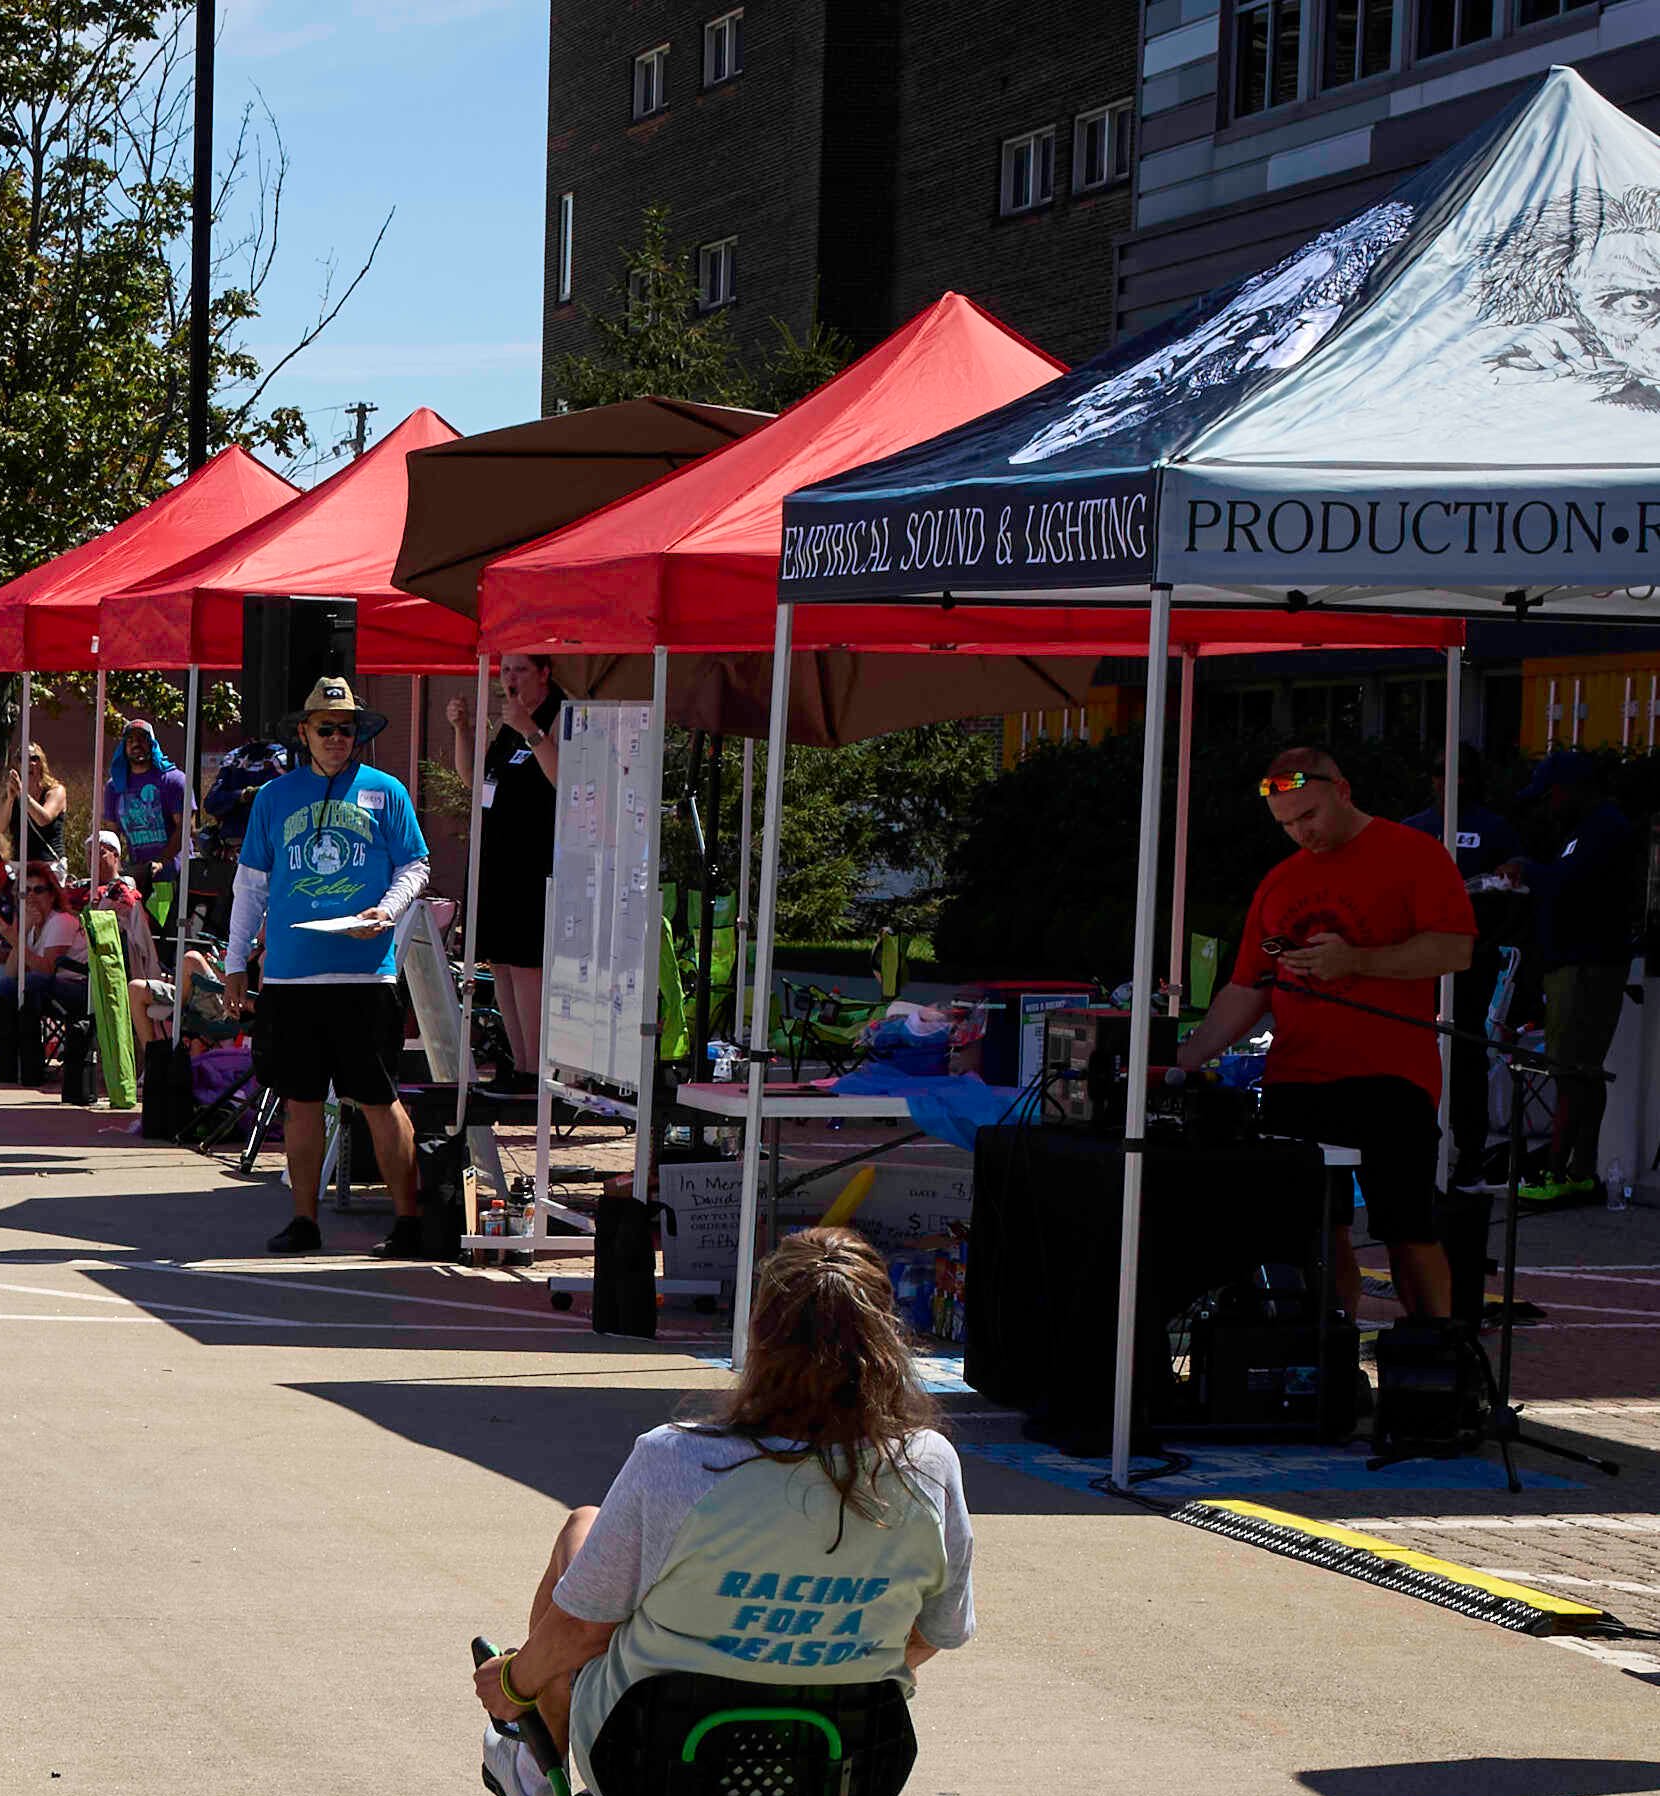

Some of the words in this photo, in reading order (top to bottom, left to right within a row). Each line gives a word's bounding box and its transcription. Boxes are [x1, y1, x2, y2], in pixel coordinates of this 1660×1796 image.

[782, 517, 893, 580] EMPIRICAL
[900, 508, 985, 571] SOUND
[996, 506, 1014, 565] &
[1025, 493, 1147, 563] LIGHTING
[288, 845, 302, 870] 20
[352, 842, 366, 866] 26
[288, 876, 366, 901] Relay
[729, 1605, 824, 1636] FOR
[831, 1608, 863, 1636] A
